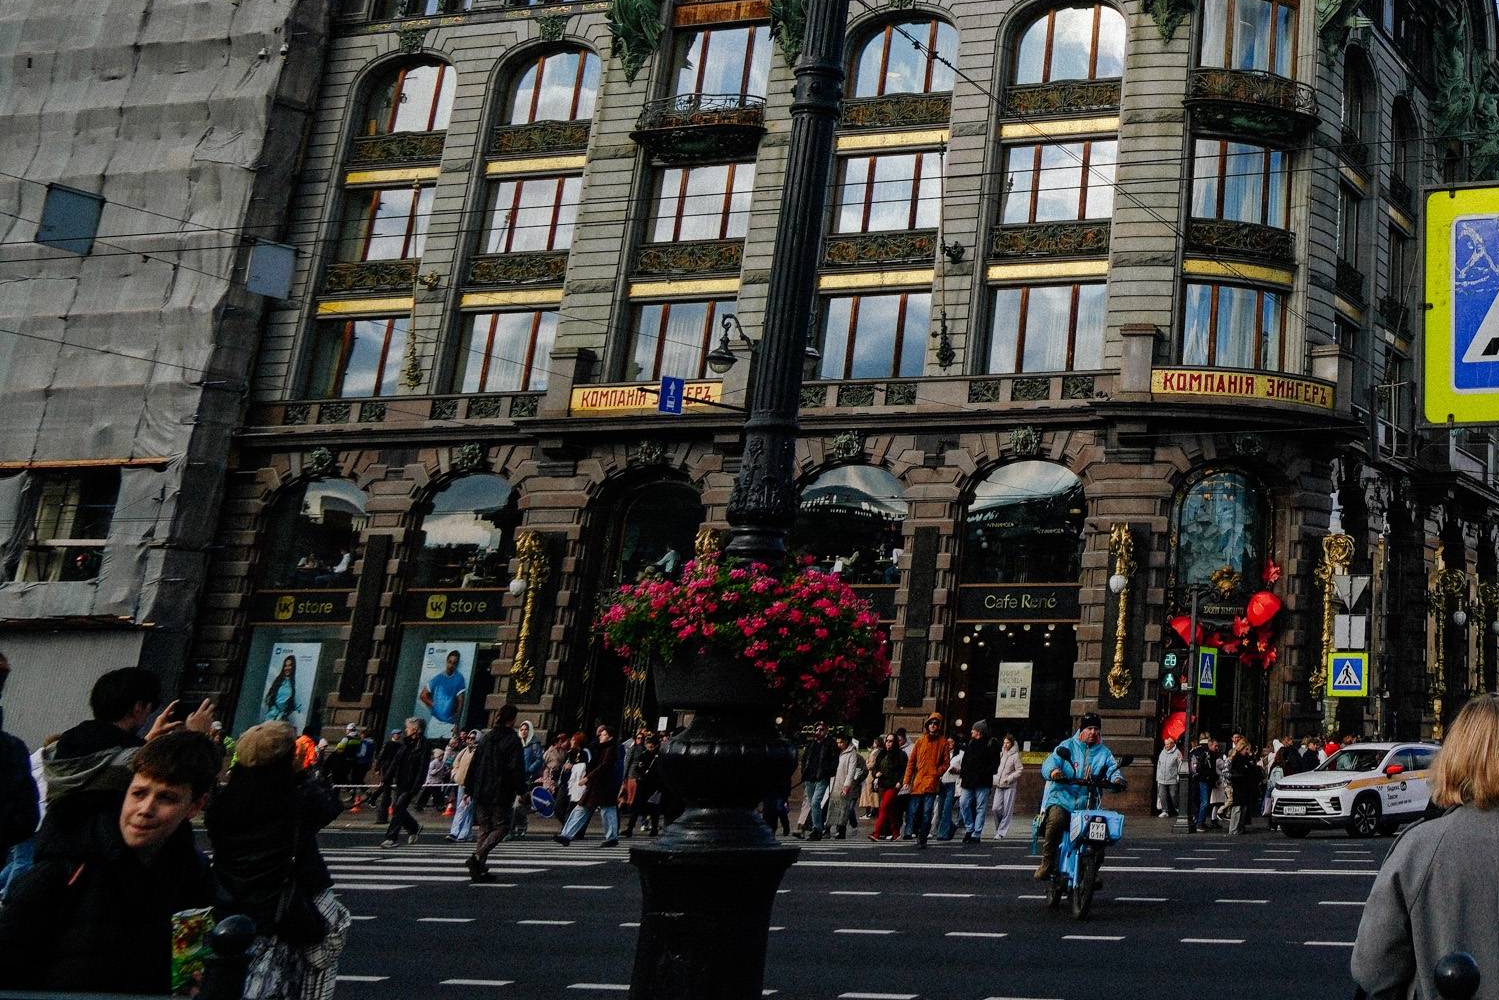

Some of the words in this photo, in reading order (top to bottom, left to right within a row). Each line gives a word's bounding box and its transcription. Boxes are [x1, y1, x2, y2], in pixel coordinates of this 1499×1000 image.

[1163, 372, 1255, 395] КОМПАНІЯ
[1266, 377, 1328, 405] ЗИНГЕРЪ
[297, 599, 334, 614] store
[449, 598, 488, 613] store
[983, 594, 1018, 609] Cafe
[1021, 591, 1057, 609] René
